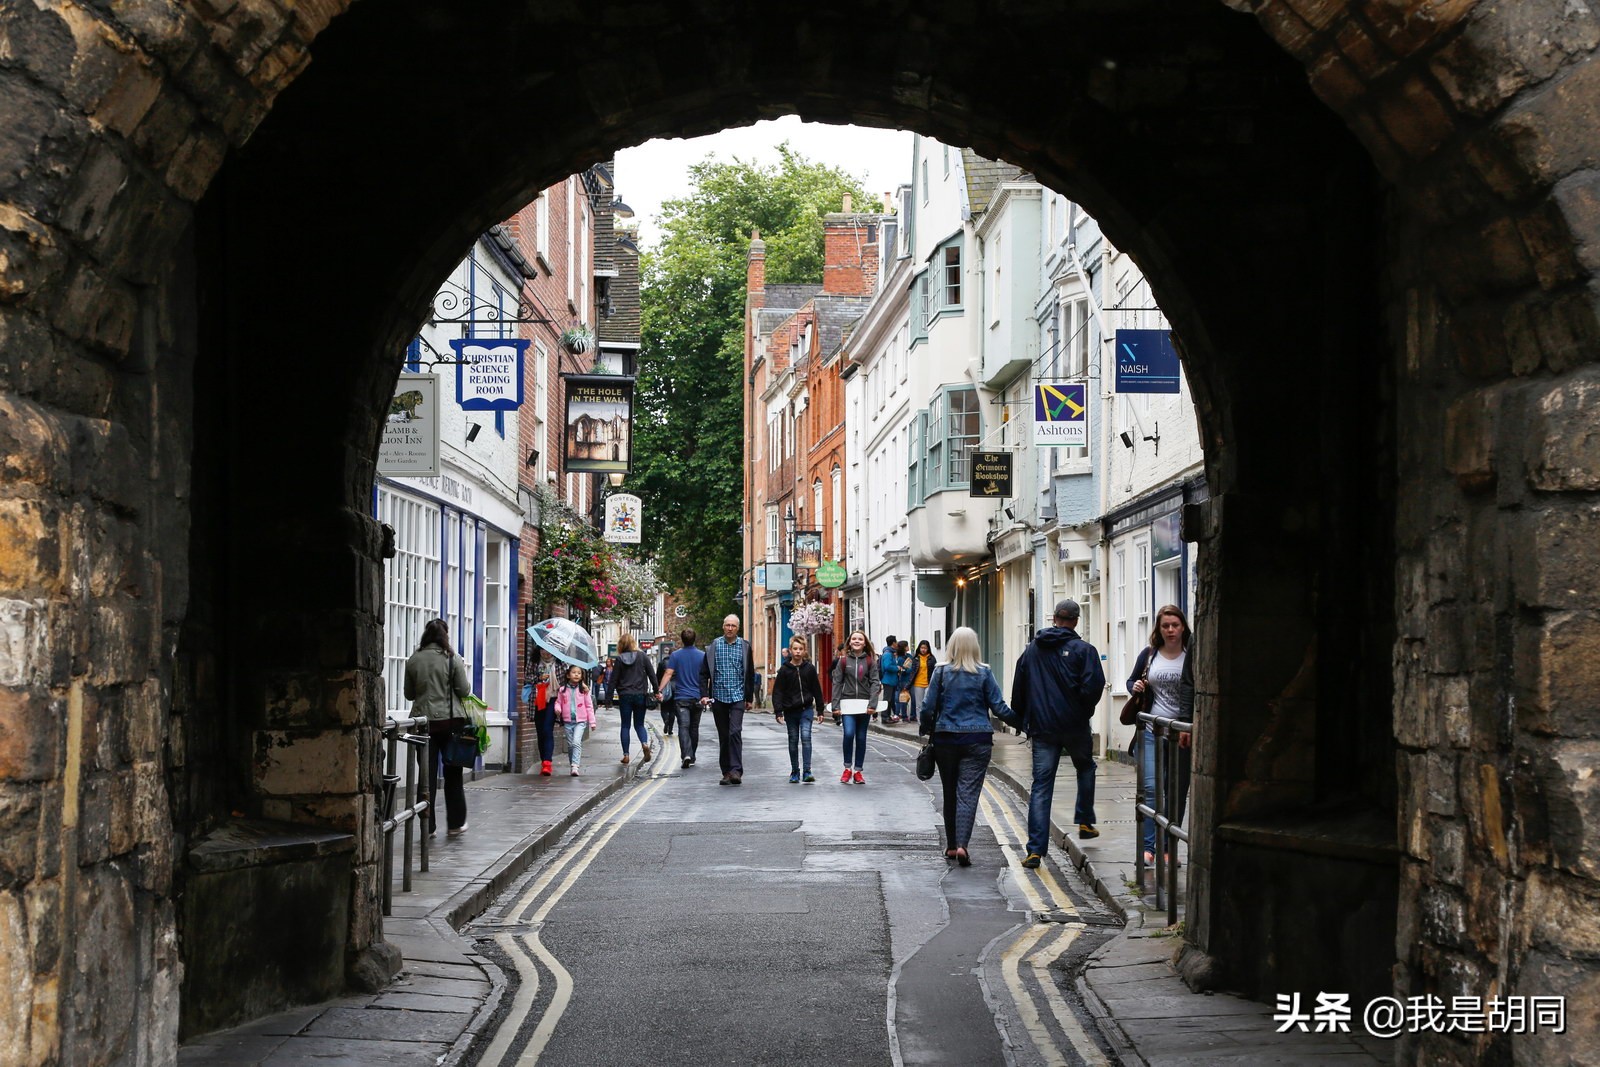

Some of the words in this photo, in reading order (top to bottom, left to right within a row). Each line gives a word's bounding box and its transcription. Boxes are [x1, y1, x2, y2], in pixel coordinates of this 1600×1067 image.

[466, 354, 514, 363] CHRISTIAN
[470, 365, 510, 374] SCIENCE
[1120, 364, 1149, 374] NAISH
[469, 376, 510, 384] READING
[476, 386, 504, 394] ROOM
[598, 388, 622, 396] HOLE
[384, 424, 410, 434] LAMB
[1037, 425, 1083, 436] Ashtons
[405, 435, 422, 444] INN
[984, 454, 999, 462] The
[976, 463, 1008, 471] Grimoire
[974, 472, 1009, 480] Bookshop
